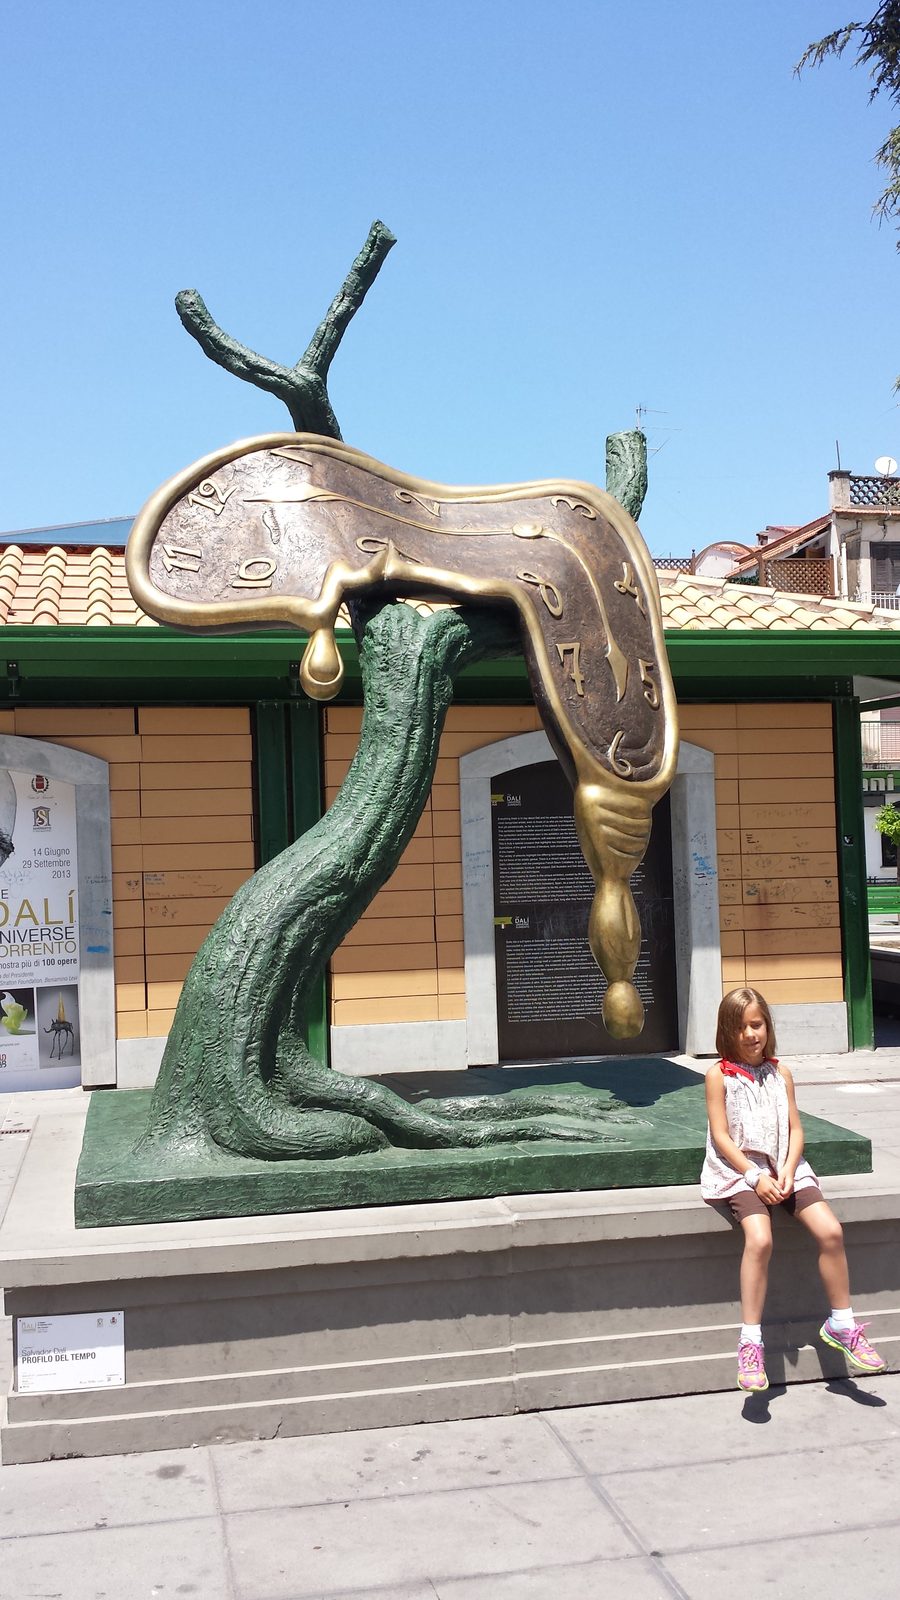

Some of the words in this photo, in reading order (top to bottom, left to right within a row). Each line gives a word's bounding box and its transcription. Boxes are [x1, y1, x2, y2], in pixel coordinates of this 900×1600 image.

[188, 477, 237, 516] 12
[162, 544, 202, 573] 11
[231, 557, 277, 588] 10
[556, 642, 585, 697] 7
[638, 658, 660, 710] 5
[607, 729, 634, 778] 6
[33, 848, 42, 857] 14
[44, 847, 71, 857] Giugno
[22, 860, 32, 869] 29
[34, 859, 71, 868] Settembre
[52, 870, 71, 879] 2013
[21, 960, 32, 969] più
[34, 959, 40, 967] di
[42, 958, 56, 967] 100
[57, 958, 78, 967] opere
[21, 1348, 52, 1357] Salvador
[22, 1355, 53, 1364] PROFILO
[55, 1354, 69, 1362] DEL
[70, 1351, 96, 1361] TEMPO
